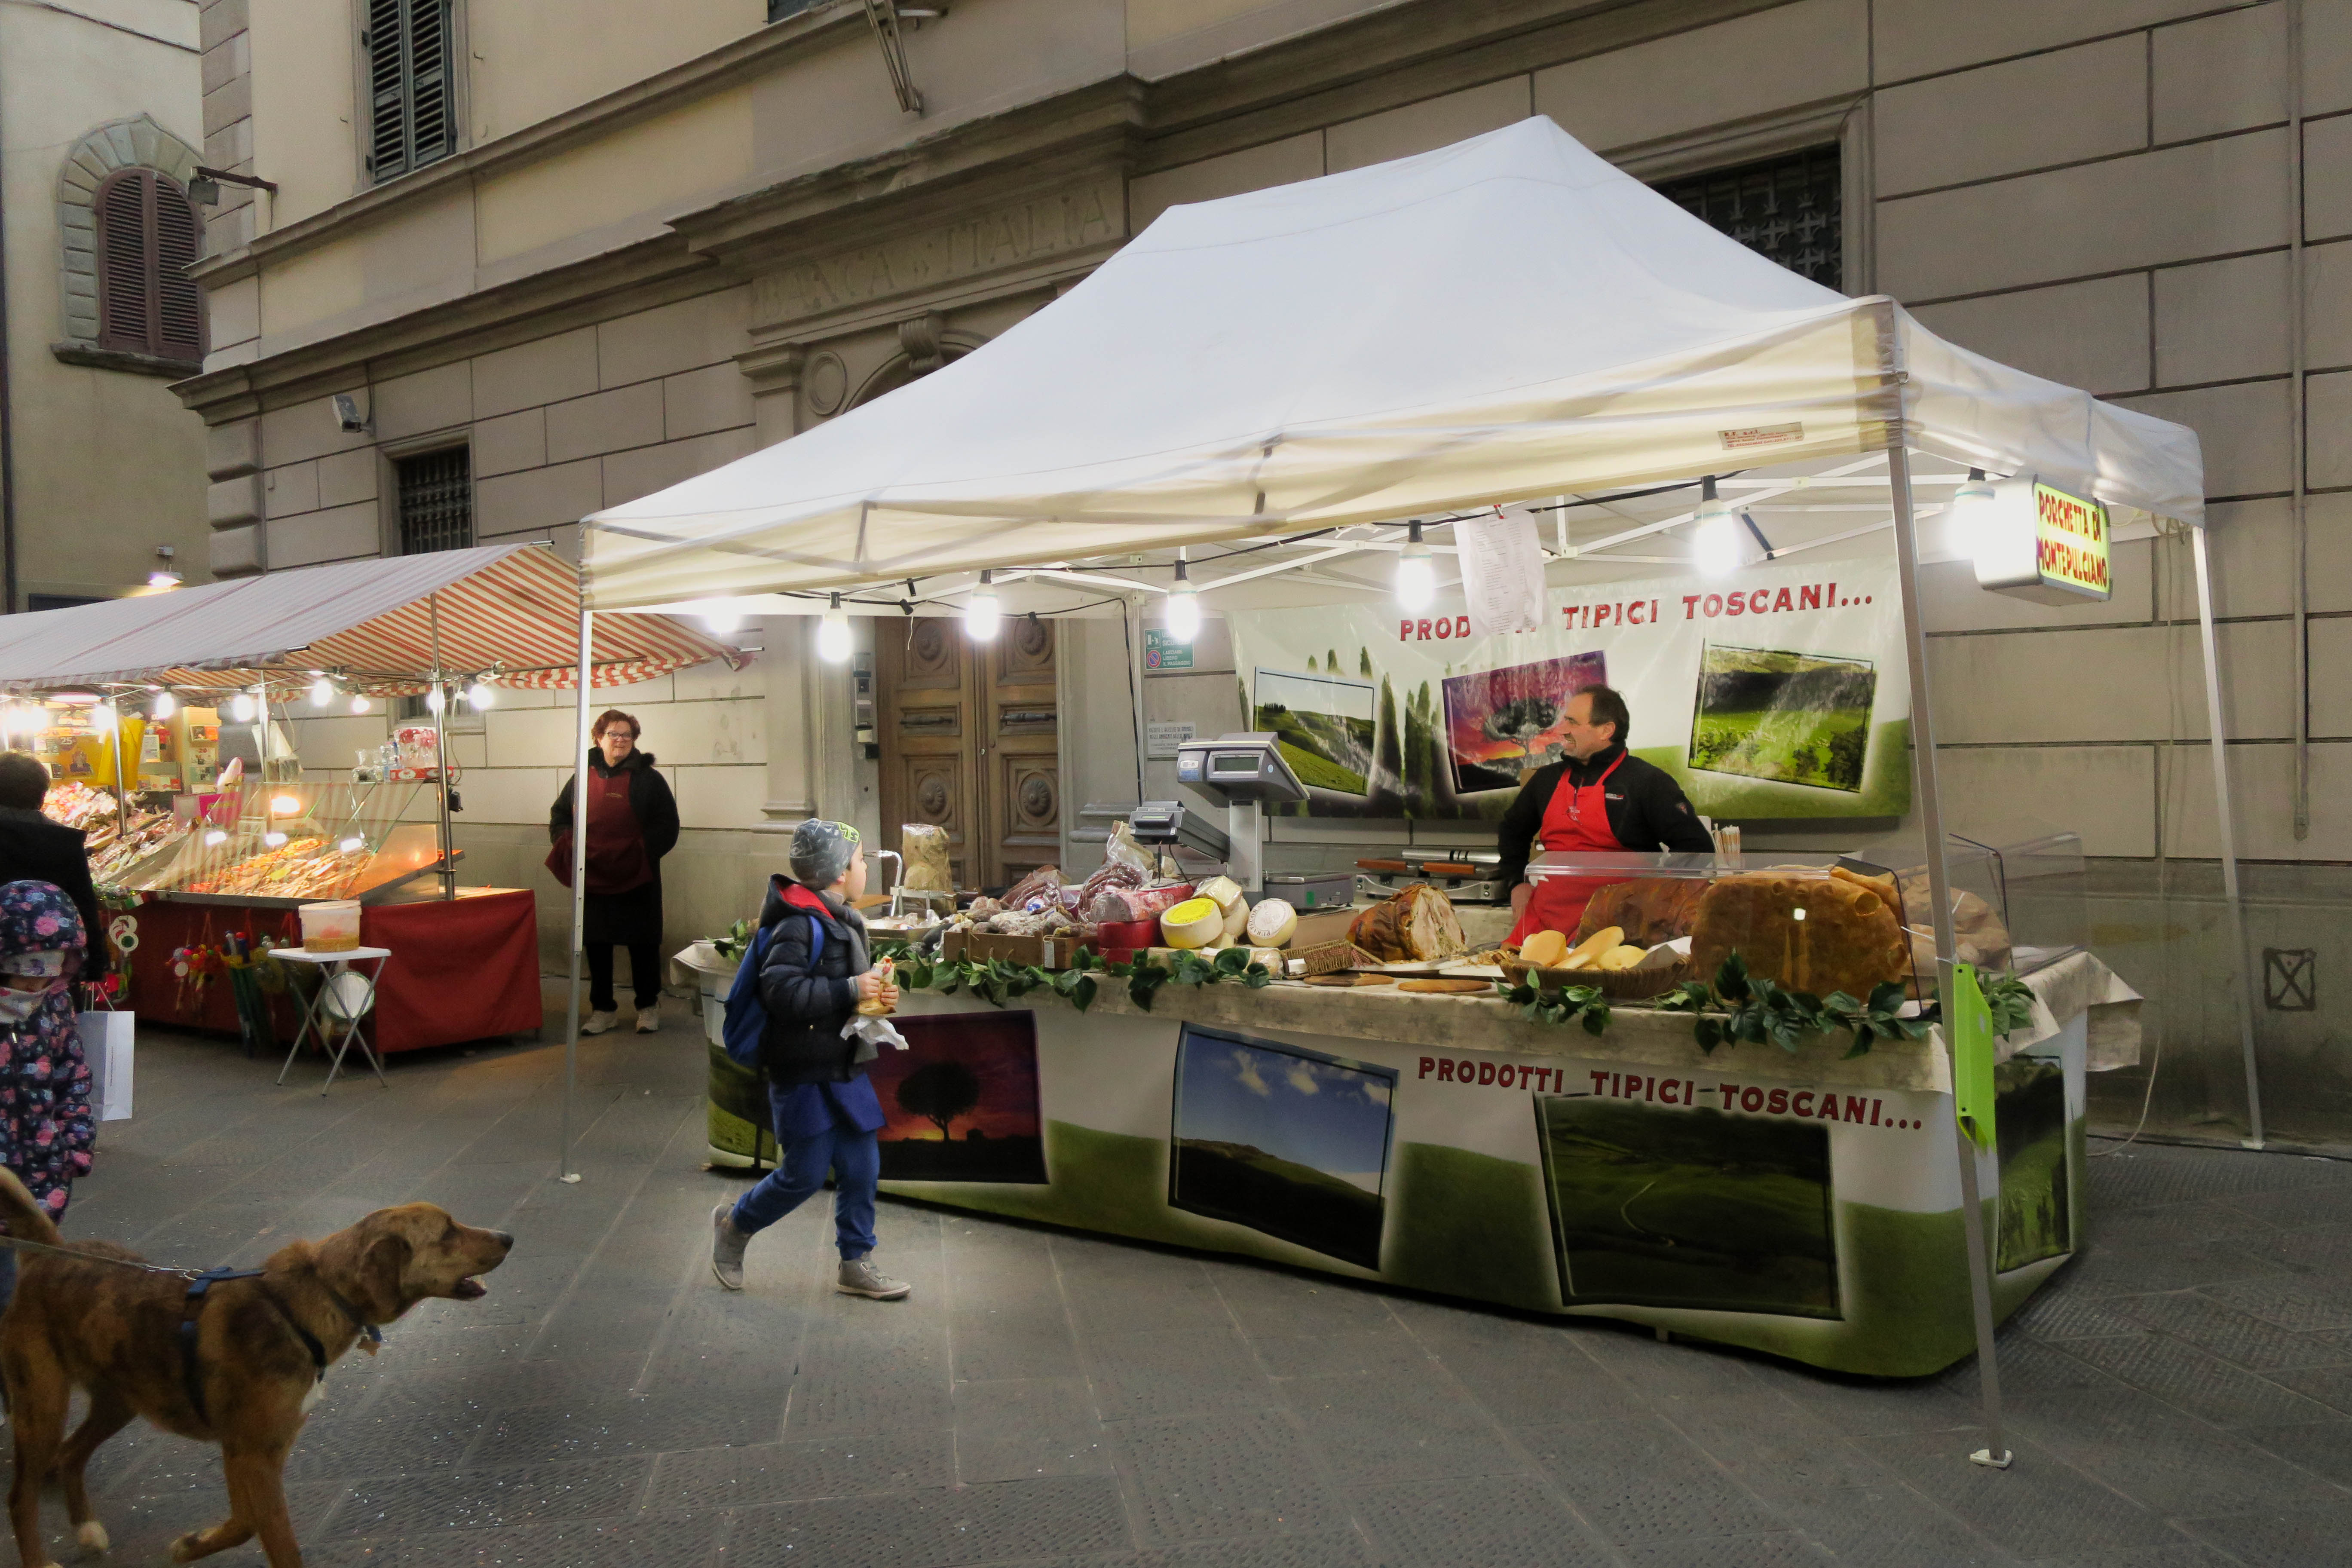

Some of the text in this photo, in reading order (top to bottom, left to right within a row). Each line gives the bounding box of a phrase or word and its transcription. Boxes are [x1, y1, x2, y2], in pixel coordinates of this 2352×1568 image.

[2039, 490, 2089, 538] PORCHETTA
[2036, 536, 2107, 588] MONTEPULCIANO
[1562, 601, 1657, 628] TIPICI
[1418, 1057, 1563, 1093] PRODOTTI
[1591, 1072, 1694, 1105] TIPICI
